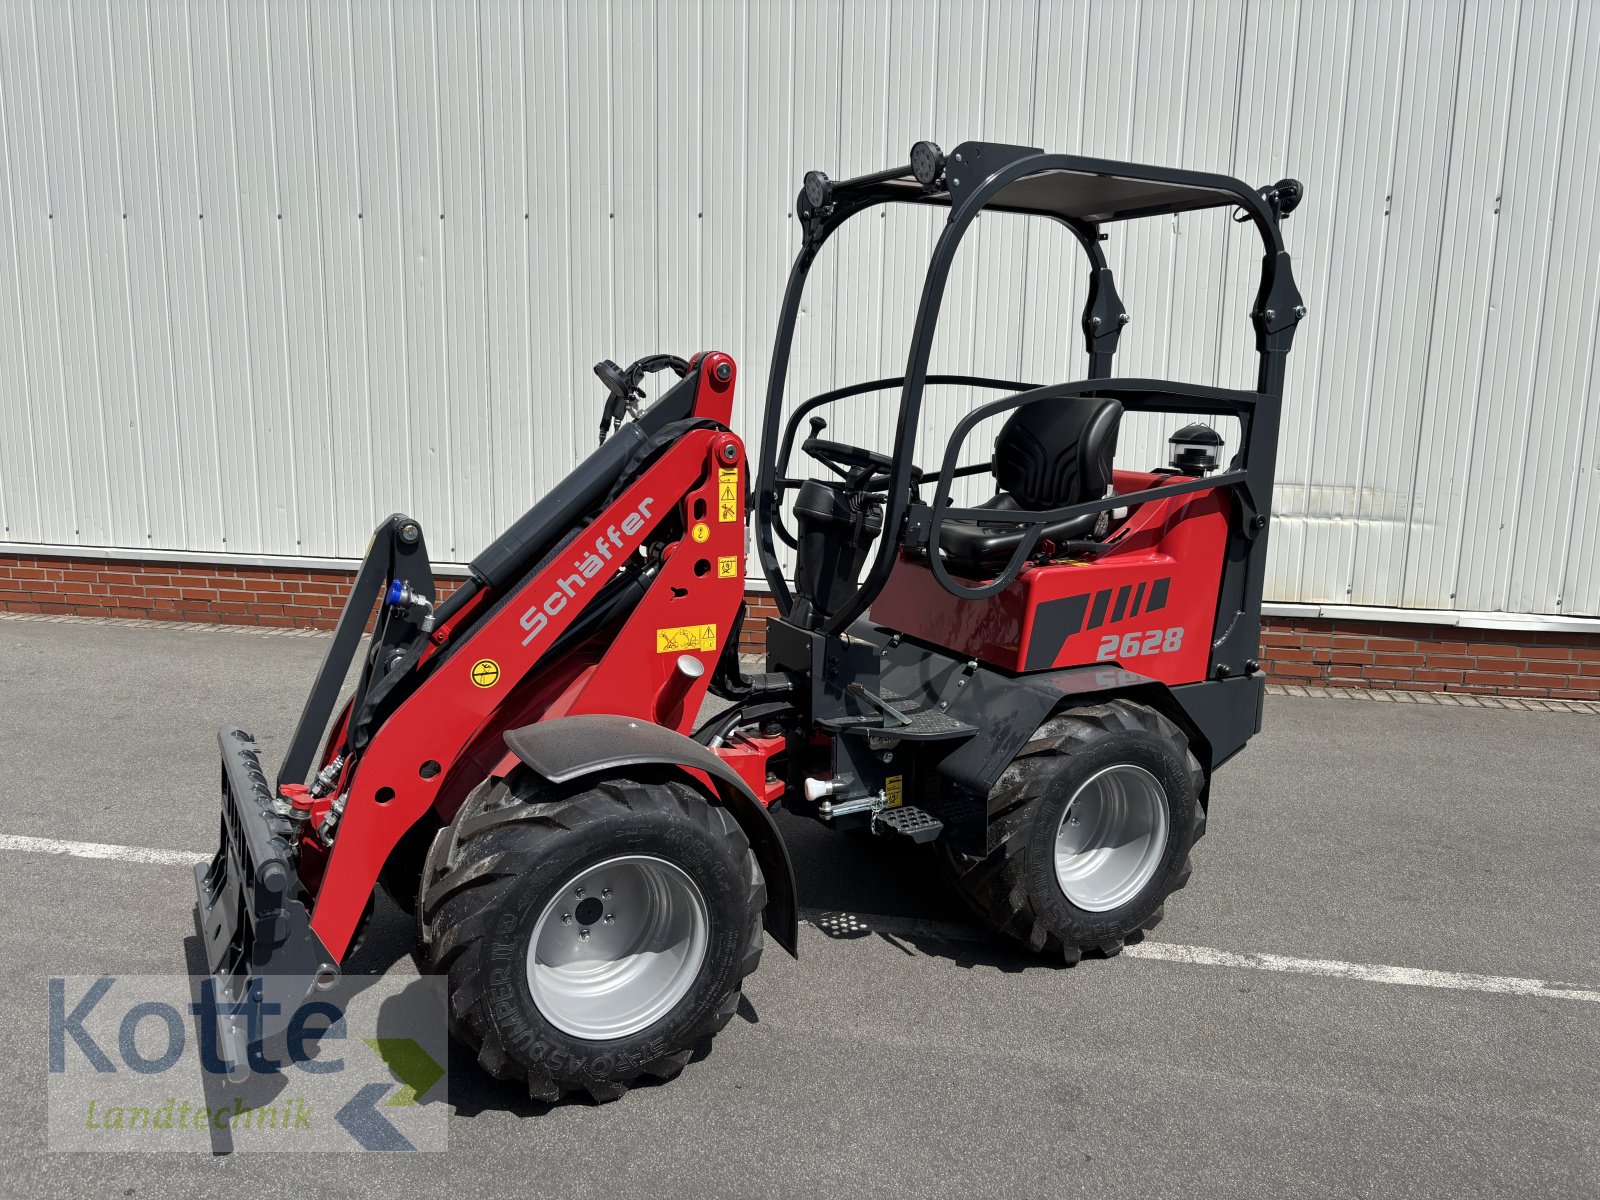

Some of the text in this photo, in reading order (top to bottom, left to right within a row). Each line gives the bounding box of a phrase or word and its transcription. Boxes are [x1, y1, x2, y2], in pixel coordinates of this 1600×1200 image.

[519, 497, 654, 647] Schäffer
[1096, 627, 1185, 662] 2628
[489, 966, 550, 1063] DUMPER
